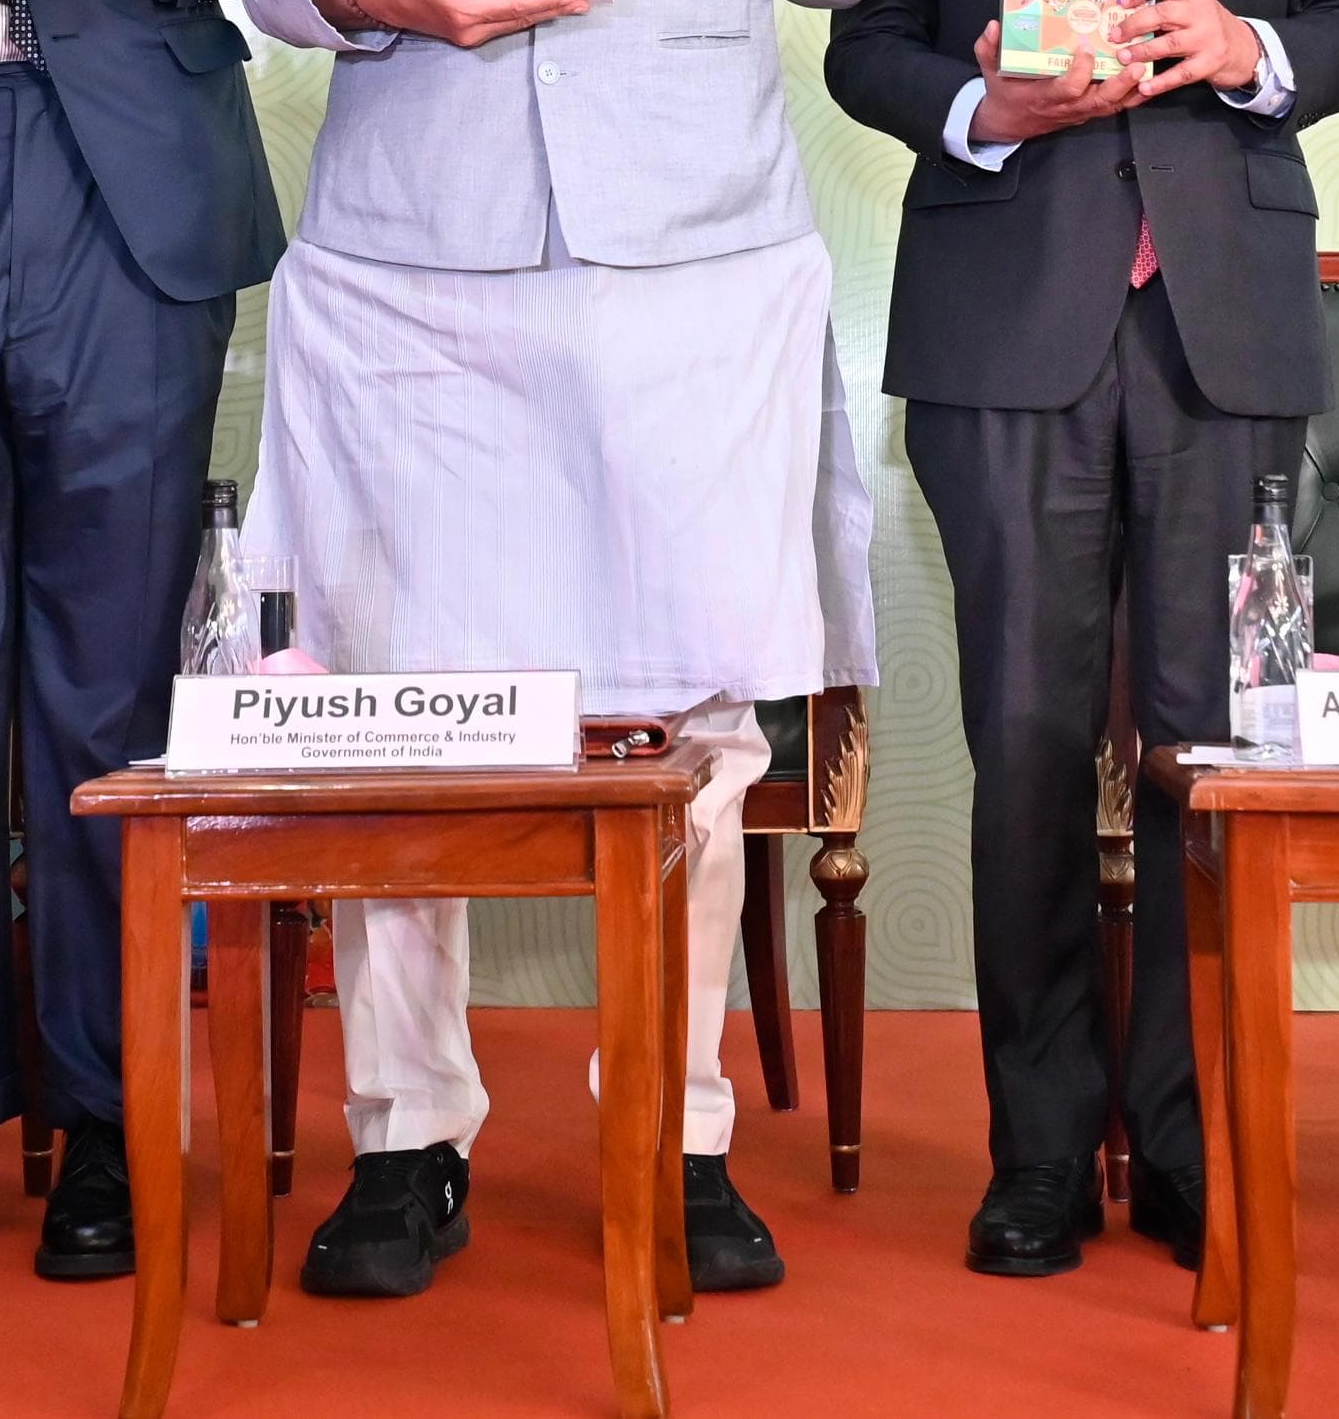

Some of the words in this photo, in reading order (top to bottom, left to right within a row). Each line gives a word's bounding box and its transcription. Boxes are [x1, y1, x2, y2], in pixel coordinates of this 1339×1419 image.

[233, 687, 377, 727] Piyush
[394, 685, 517, 725] Goyal
[230, 733, 282, 745] Hon'ble
[287, 732, 341, 744] Minister
[347, 732, 361, 743] of
[364, 732, 439, 743] Commerce
[444, 732, 454, 742] &
[459, 731, 516, 746] Industry
[301, 746, 387, 759] Government
[391, 746, 405, 758] of
[408, 745, 442, 758] India
